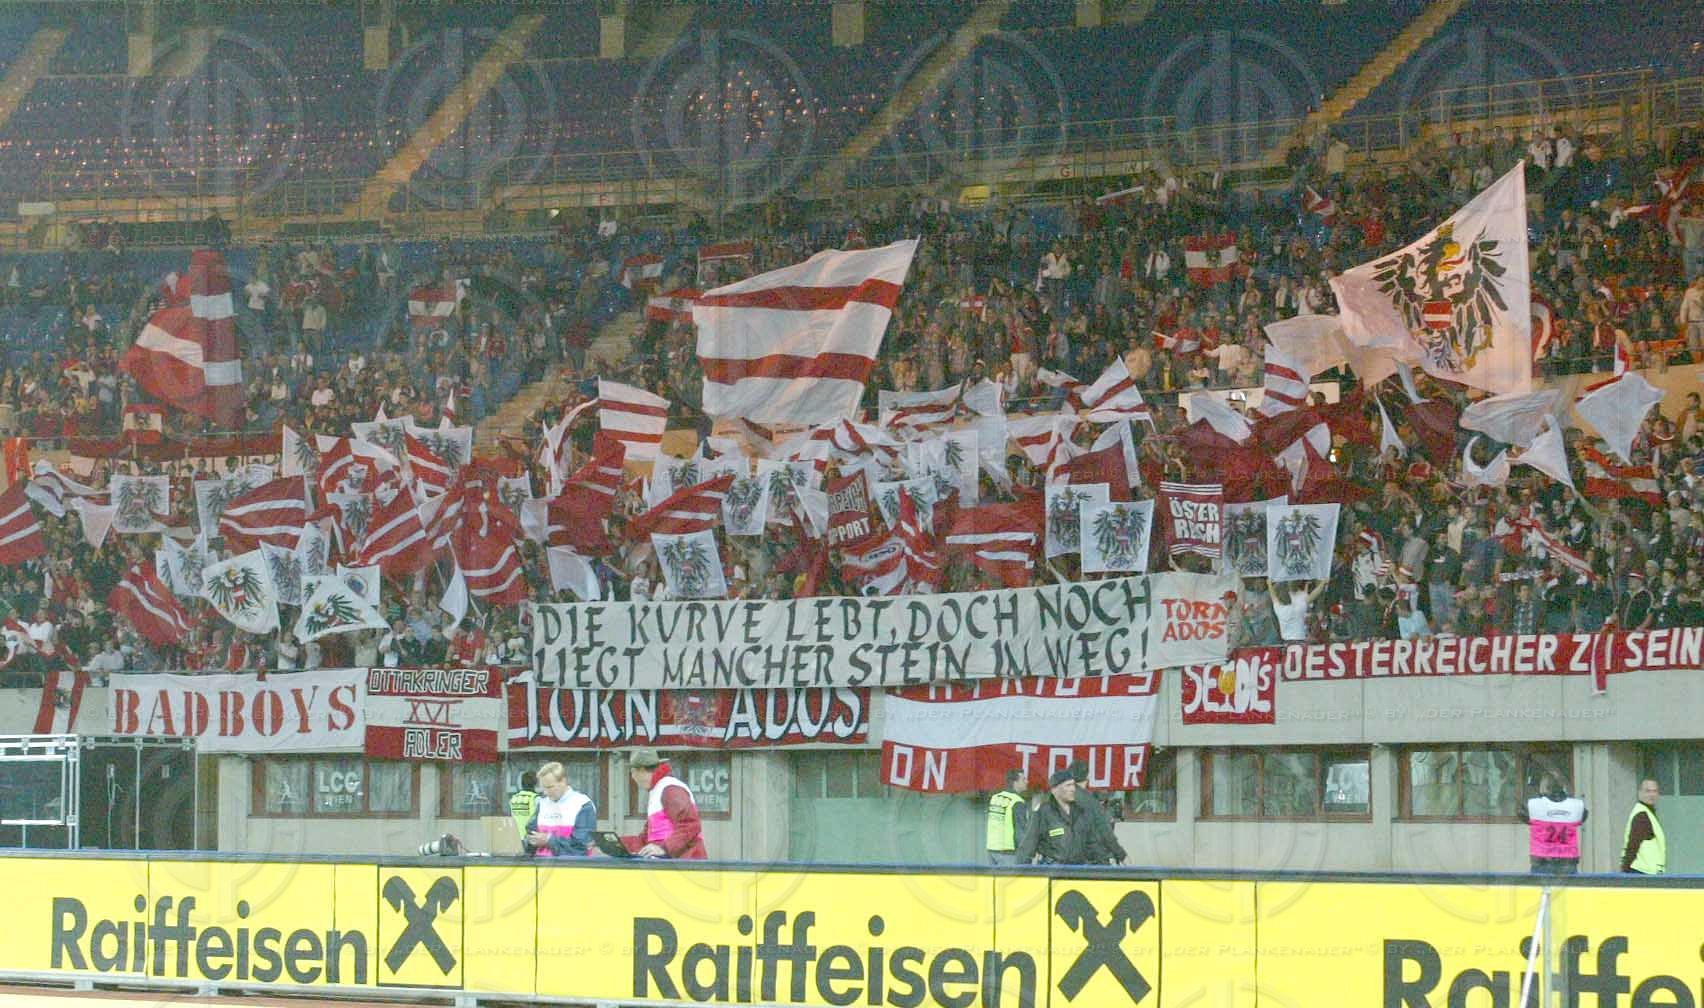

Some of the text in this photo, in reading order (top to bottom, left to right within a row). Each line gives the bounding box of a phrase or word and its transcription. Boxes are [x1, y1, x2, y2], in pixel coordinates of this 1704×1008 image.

[536, 604, 606, 648] DIE
[628, 601, 769, 645] KURVE
[907, 592, 1019, 643] DOCH
[1034, 576, 1152, 631] NOCH
[1162, 621, 1224, 642] ADOS
[535, 645, 645, 689] LIEGT
[663, 644, 833, 687] MANCHER
[849, 640, 973, 687] STEIN
[991, 639, 1032, 679] IM
[1044, 627, 1149, 678] WEG!
[1284, 635, 1560, 680] OESTERREICHER
[1624, 627, 1704, 668] SEIN
[369, 668, 490, 694] OTTAKRINGER
[402, 698, 464, 728] XVI
[404, 729, 463, 759] ADLER
[889, 744, 948, 790] ON
[690, 768, 730, 792] LCC
[51, 894, 368, 984] Raiffeisen
[633, 910, 1038, 1008] Raiffeisen
